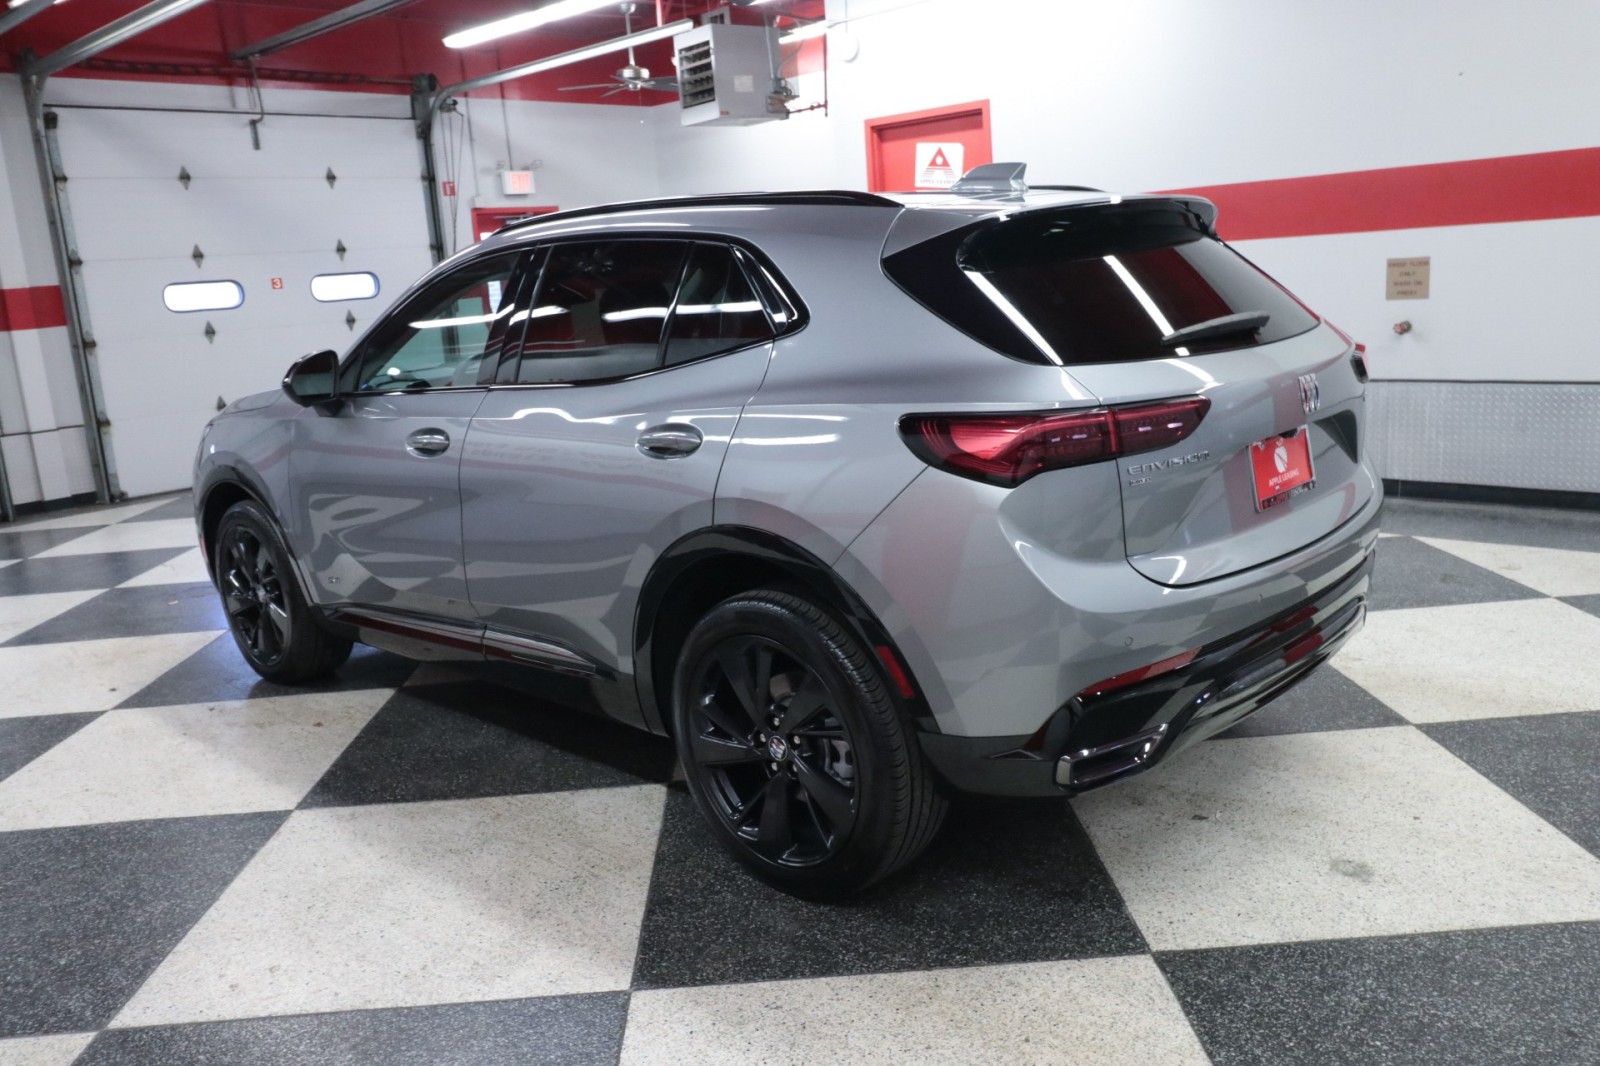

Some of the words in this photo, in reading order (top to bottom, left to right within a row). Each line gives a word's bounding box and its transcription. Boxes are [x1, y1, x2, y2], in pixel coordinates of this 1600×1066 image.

[273, 278, 281, 289] 3
[1127, 450, 1210, 475] ENVISION
[1268, 474, 1282, 486] APPLE
[1282, 468, 1300, 481] LEASING
